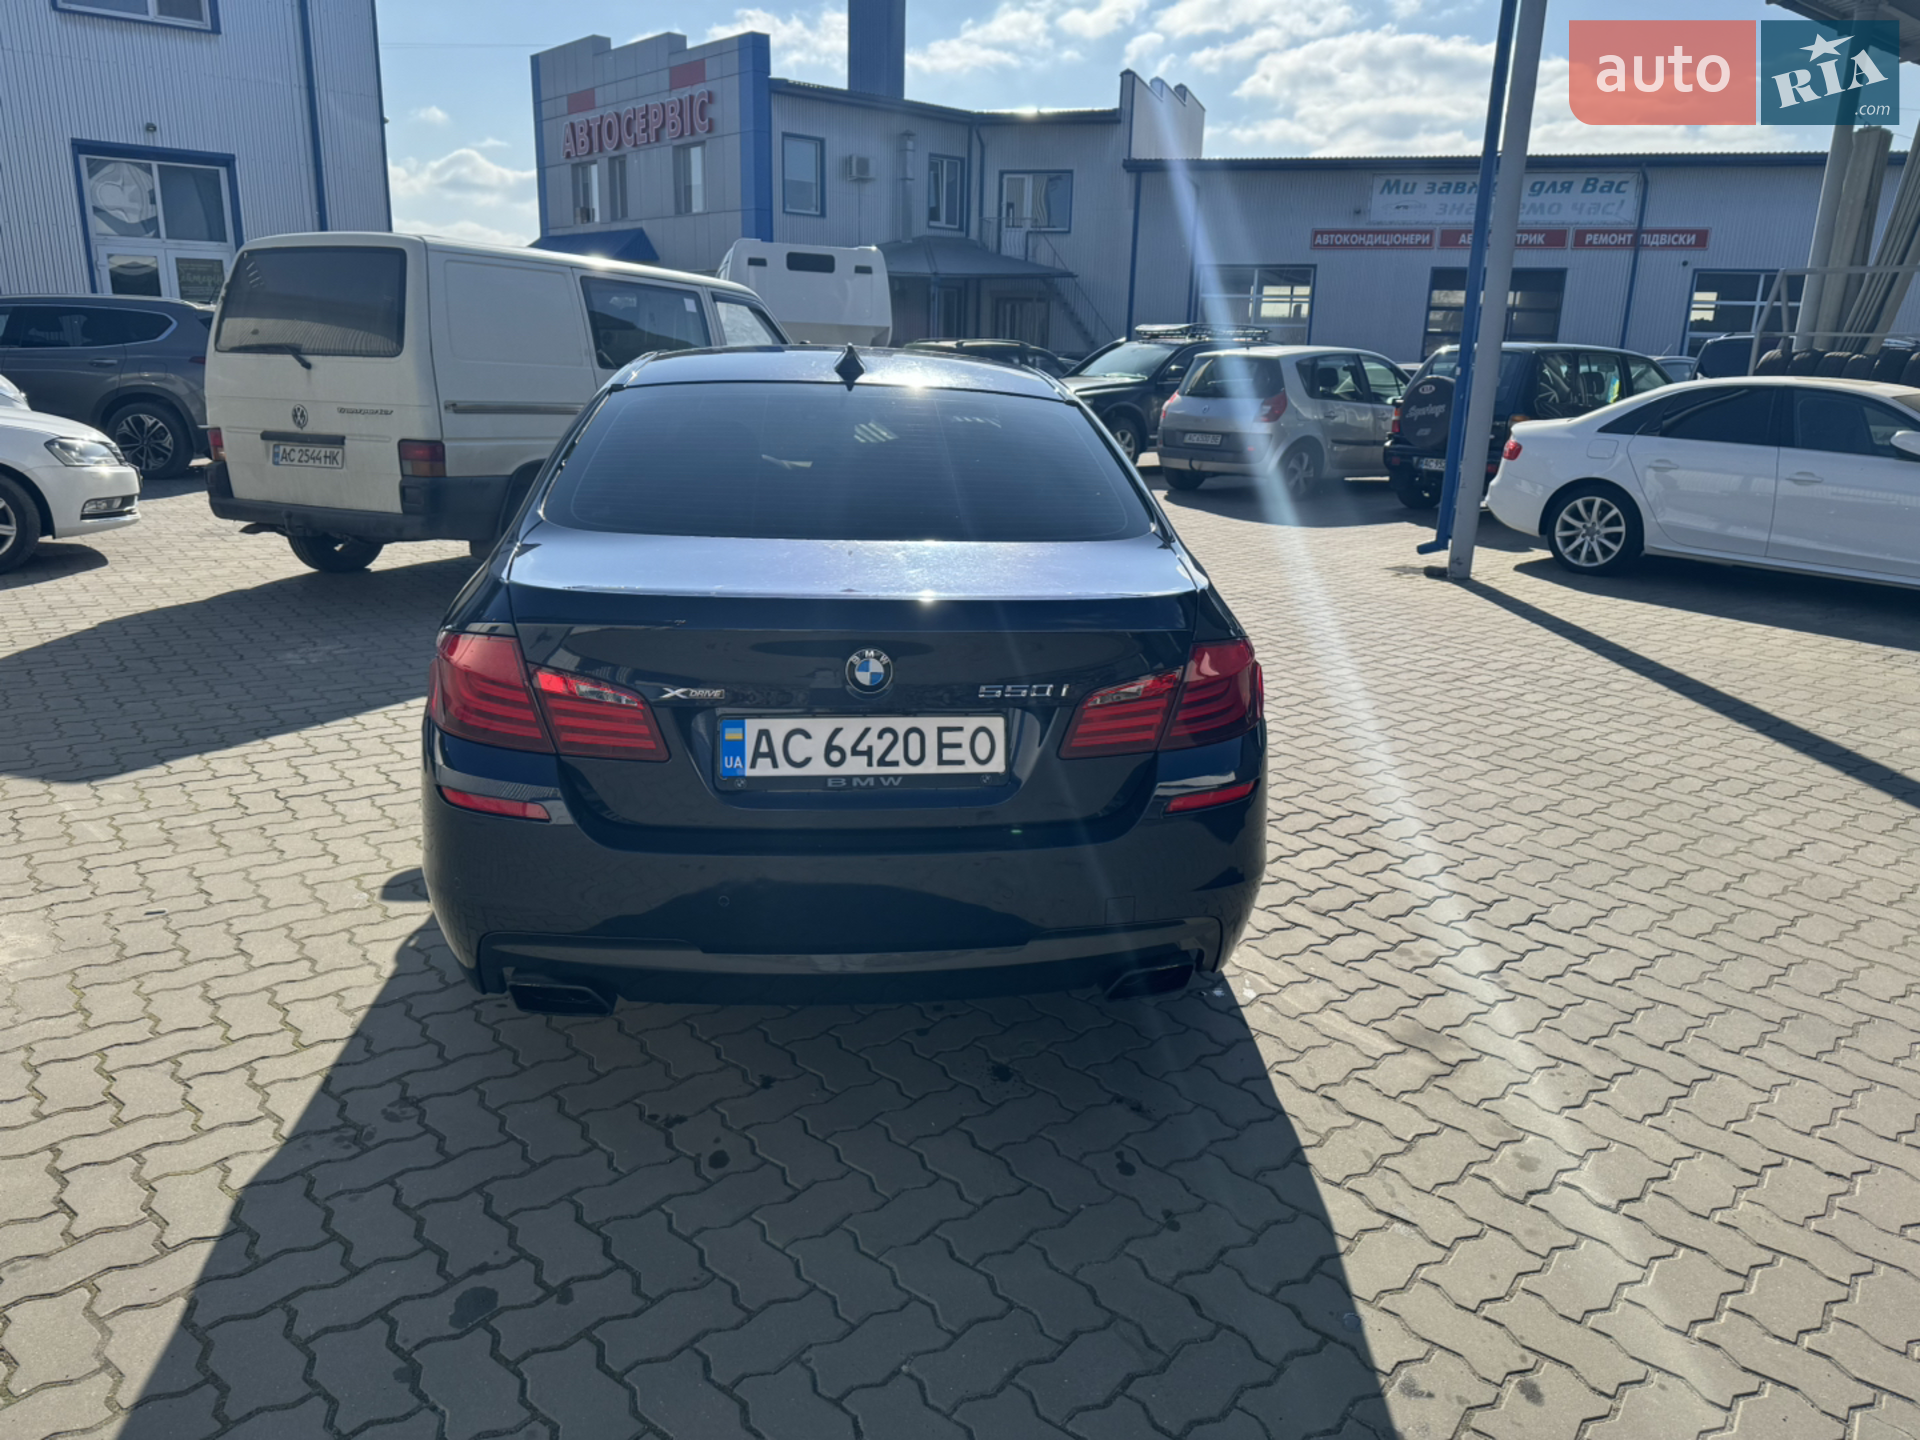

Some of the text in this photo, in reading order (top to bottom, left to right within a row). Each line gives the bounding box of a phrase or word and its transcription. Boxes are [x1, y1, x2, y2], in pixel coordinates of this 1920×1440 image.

[562, 88, 714, 159] АВТОСЕРВІС
[1380, 179, 1418, 196] Ми
[1528, 180, 1575, 197] для
[1581, 177, 1629, 195] Вас
[1571, 200, 1626, 216] час!
[1315, 233, 1431, 247] АВТОКОНДИЦІОНЕРИ
[1585, 233, 1697, 247] РЕМОНТ ПІДВІСКИ
[280, 448, 296, 463] AC
[298, 449, 322, 465] 2544
[850, 650, 890, 665] BMW
[749, 725, 996, 769] AC 6420 EO
[724, 756, 744, 769] UA
[826, 776, 903, 788] BMW
